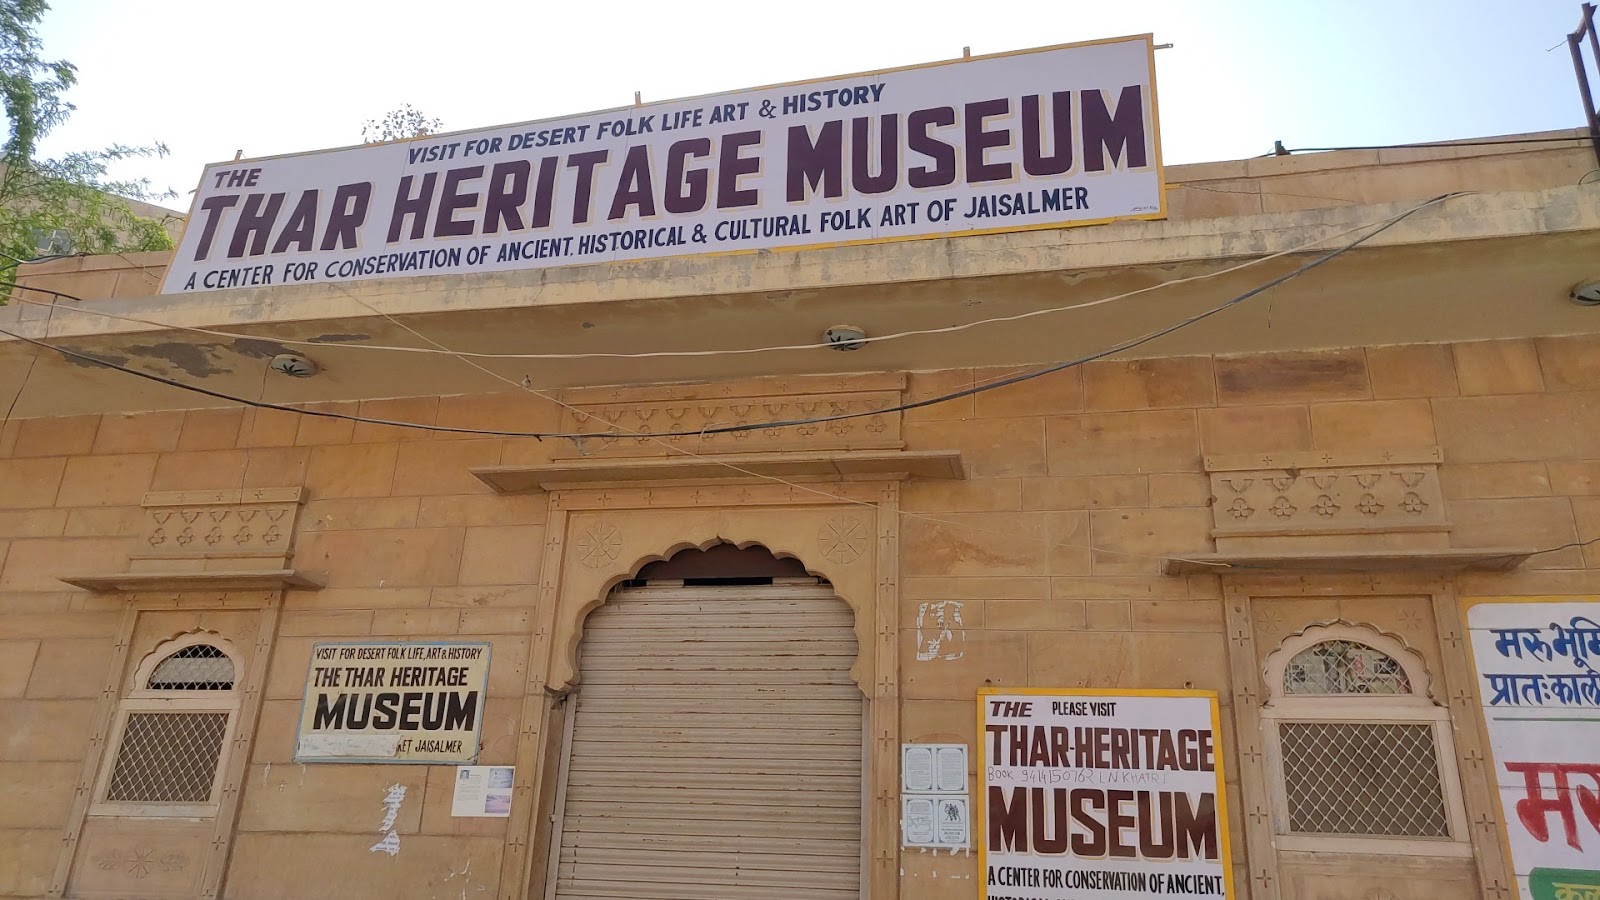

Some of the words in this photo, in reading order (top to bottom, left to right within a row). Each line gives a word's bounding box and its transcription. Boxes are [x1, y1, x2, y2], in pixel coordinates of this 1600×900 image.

[409, 143, 460, 164] VISIT
[464, 138, 502, 157] FOR
[507, 125, 590, 151] DESERT
[597, 115, 655, 140] FOLK
[661, 108, 703, 131] LIFE
[709, 102, 749, 124] ART
[758, 99, 776, 119] &
[783, 83, 886, 115] HISTORY
[194, 182, 372, 262] THAR
[386, 130, 761, 244] HERITAGE
[786, 85, 1147, 203] MUSEUM
[215, 168, 262, 189] THE
[184, 272, 197, 290] A
[203, 264, 273, 289] CENTER
[283, 262, 318, 282] FOR
[325, 248, 460, 278] CONSERVATION
[466, 246, 491, 265] OF
[578, 226, 686, 255] HISTORICAL
[692, 223, 707, 244] &
[714, 214, 811, 241] CULTURAL
[820, 208, 871, 232] FOLK
[880, 202, 919, 226] ART
[927, 198, 957, 223] OF
[963, 186, 1089, 218] JAISALMER
[316, 648, 336, 660] VISIT
[340, 648, 355, 659] FOR
[357, 648, 385, 660] DESERT
[387, 648, 406, 660] FOLK
[426, 648, 441, 660] ART
[448, 648, 483, 660] HISTORY
[314, 667, 342, 687] THE
[344, 667, 385, 687] THAR
[389, 667, 469, 687] HERITAGE
[312, 691, 478, 731] MUSEUM
[990, 701, 1033, 718] THE
[1052, 701, 1087, 716] PLEASE
[1090, 702, 1116, 717] VISIT
[415, 739, 463, 754] JAISALMER
[988, 786, 1218, 860] MUSEUM
[987, 866, 996, 886] A
[998, 867, 1040, 888] CENTER
[1043, 869, 1064, 889] FOR
[1065, 869, 1146, 892] CONSERVATION
[1149, 873, 1165, 894] OF
[1166, 874, 1225, 896] ANCIENT,
